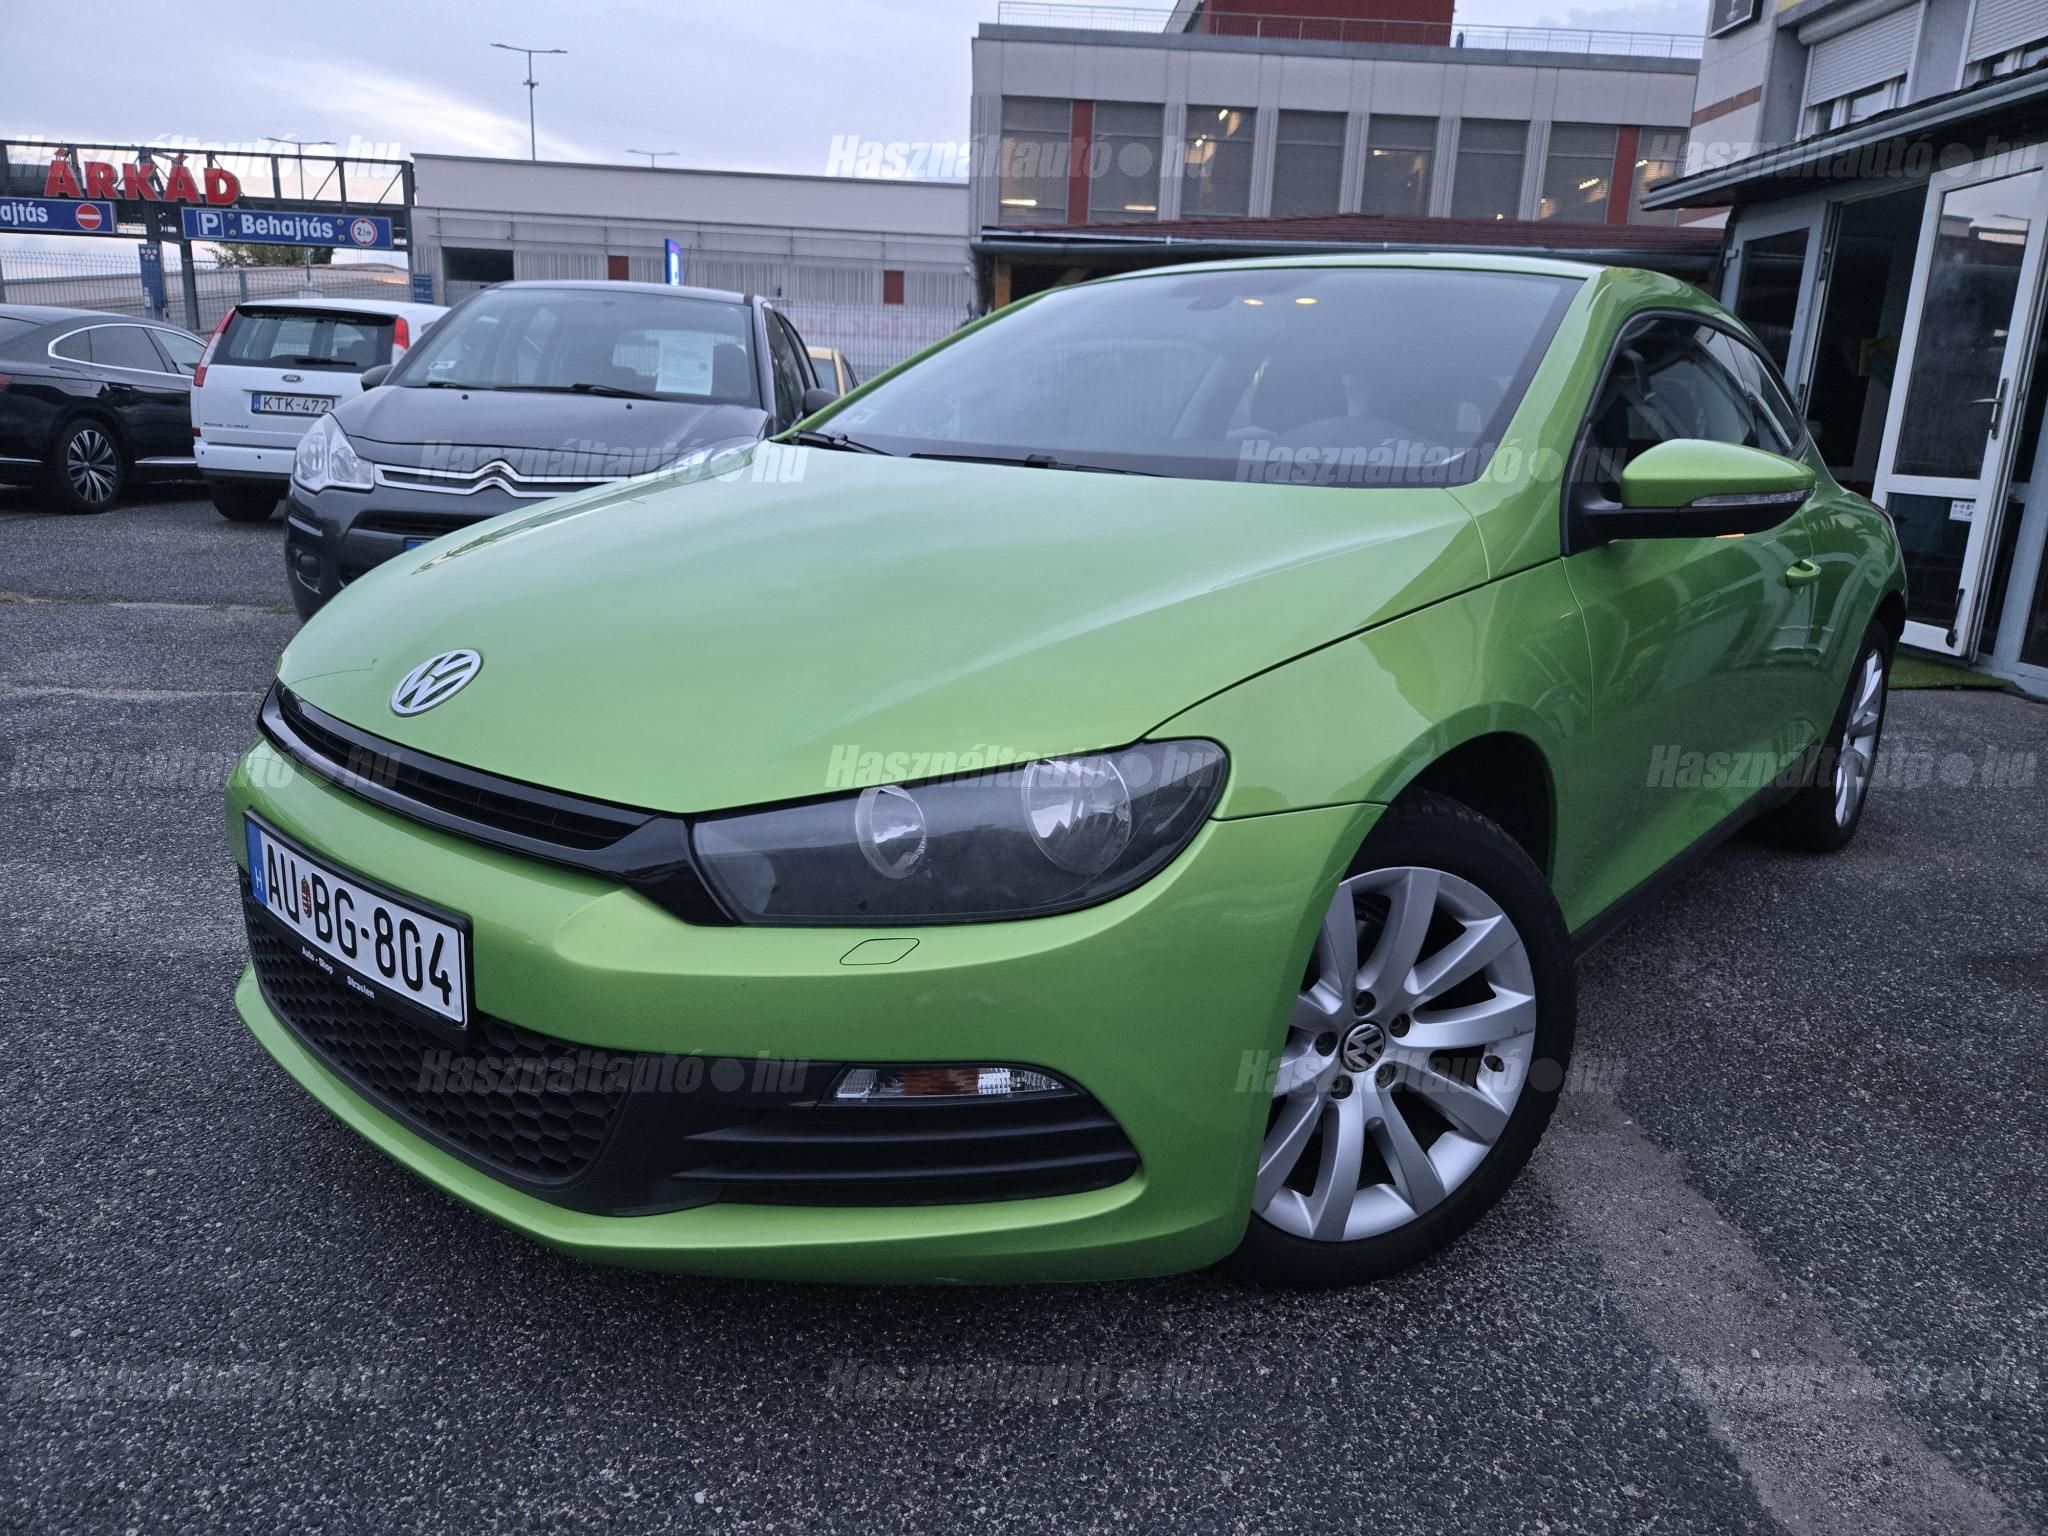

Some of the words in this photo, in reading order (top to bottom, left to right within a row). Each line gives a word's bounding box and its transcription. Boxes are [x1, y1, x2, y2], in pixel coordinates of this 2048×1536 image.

[44, 147, 242, 206] ÁRKÁD
[200, 213, 219, 235] P
[241, 214, 334, 240] Behajtás
[263, 397, 330, 413] KTK-472
[254, 866, 263, 892] H
[267, 843, 300, 924] AU
[311, 872, 453, 1006] BG-804
